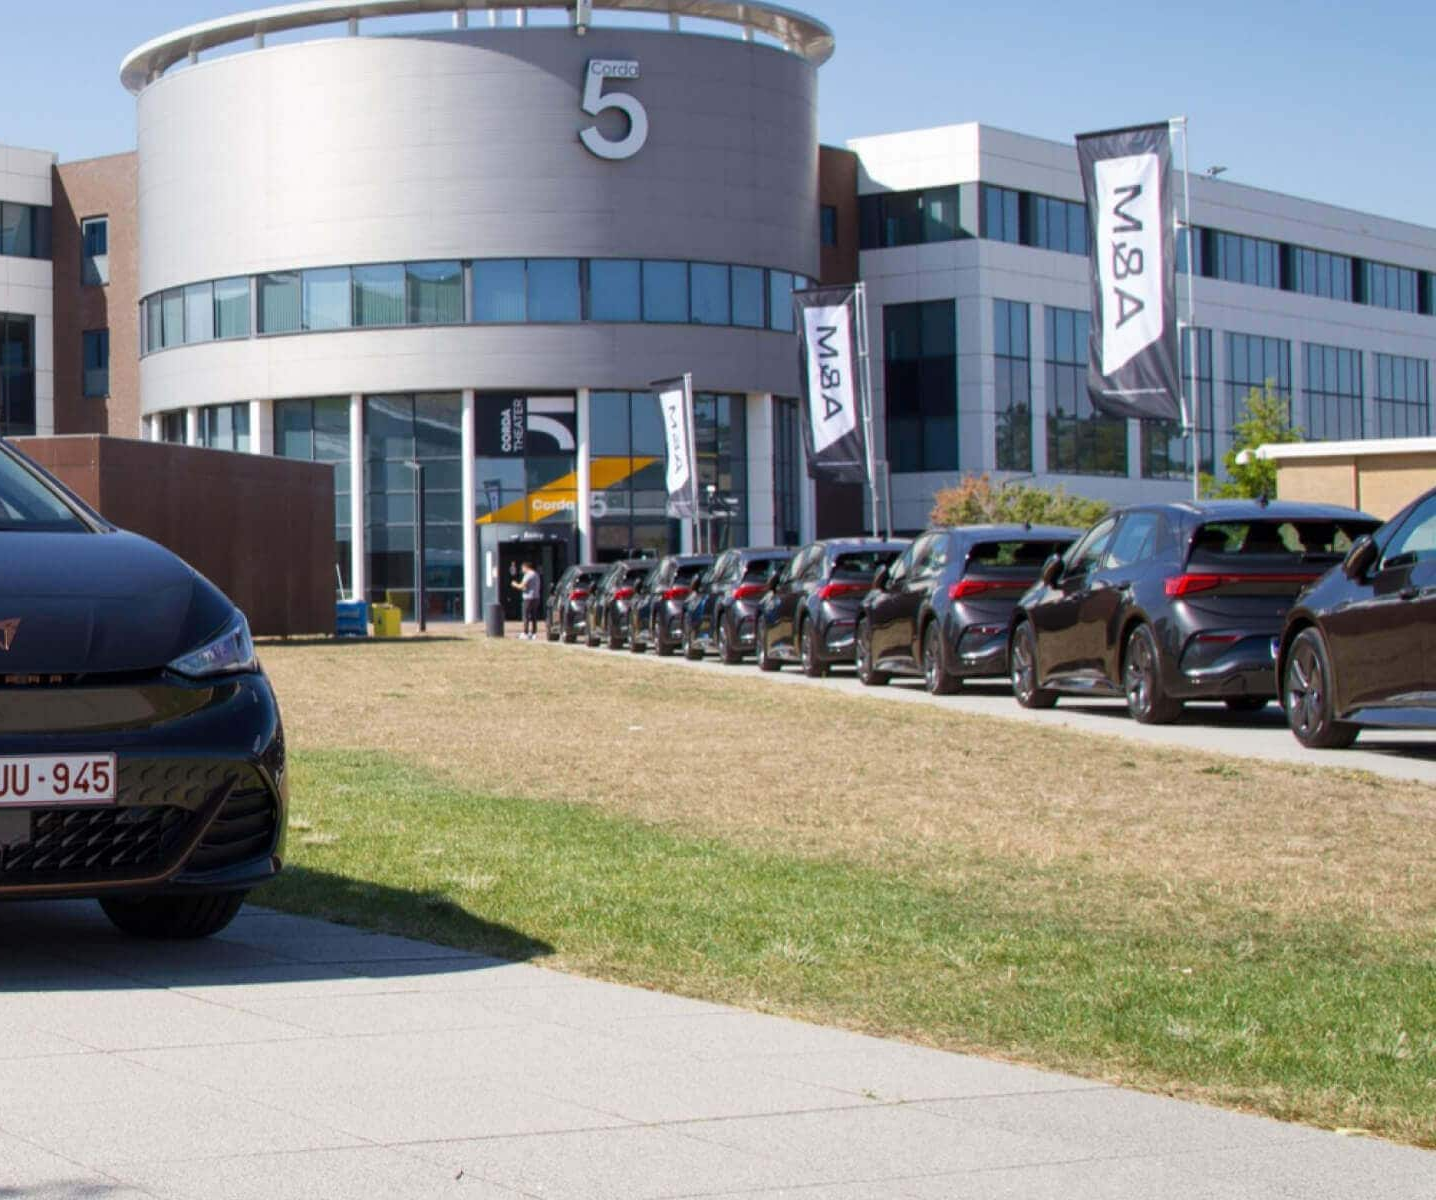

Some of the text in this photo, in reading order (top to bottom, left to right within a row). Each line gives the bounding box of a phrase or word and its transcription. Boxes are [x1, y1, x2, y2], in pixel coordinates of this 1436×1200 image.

[591, 62, 638, 75] Corda
[579, 59, 648, 159] 5
[1112, 183, 1145, 330] M&A
[816, 325, 844, 422] M&A
[501, 408, 512, 452] CORDA
[513, 398, 524, 452] THEATER
[532, 491, 607, 518] Corda 5
